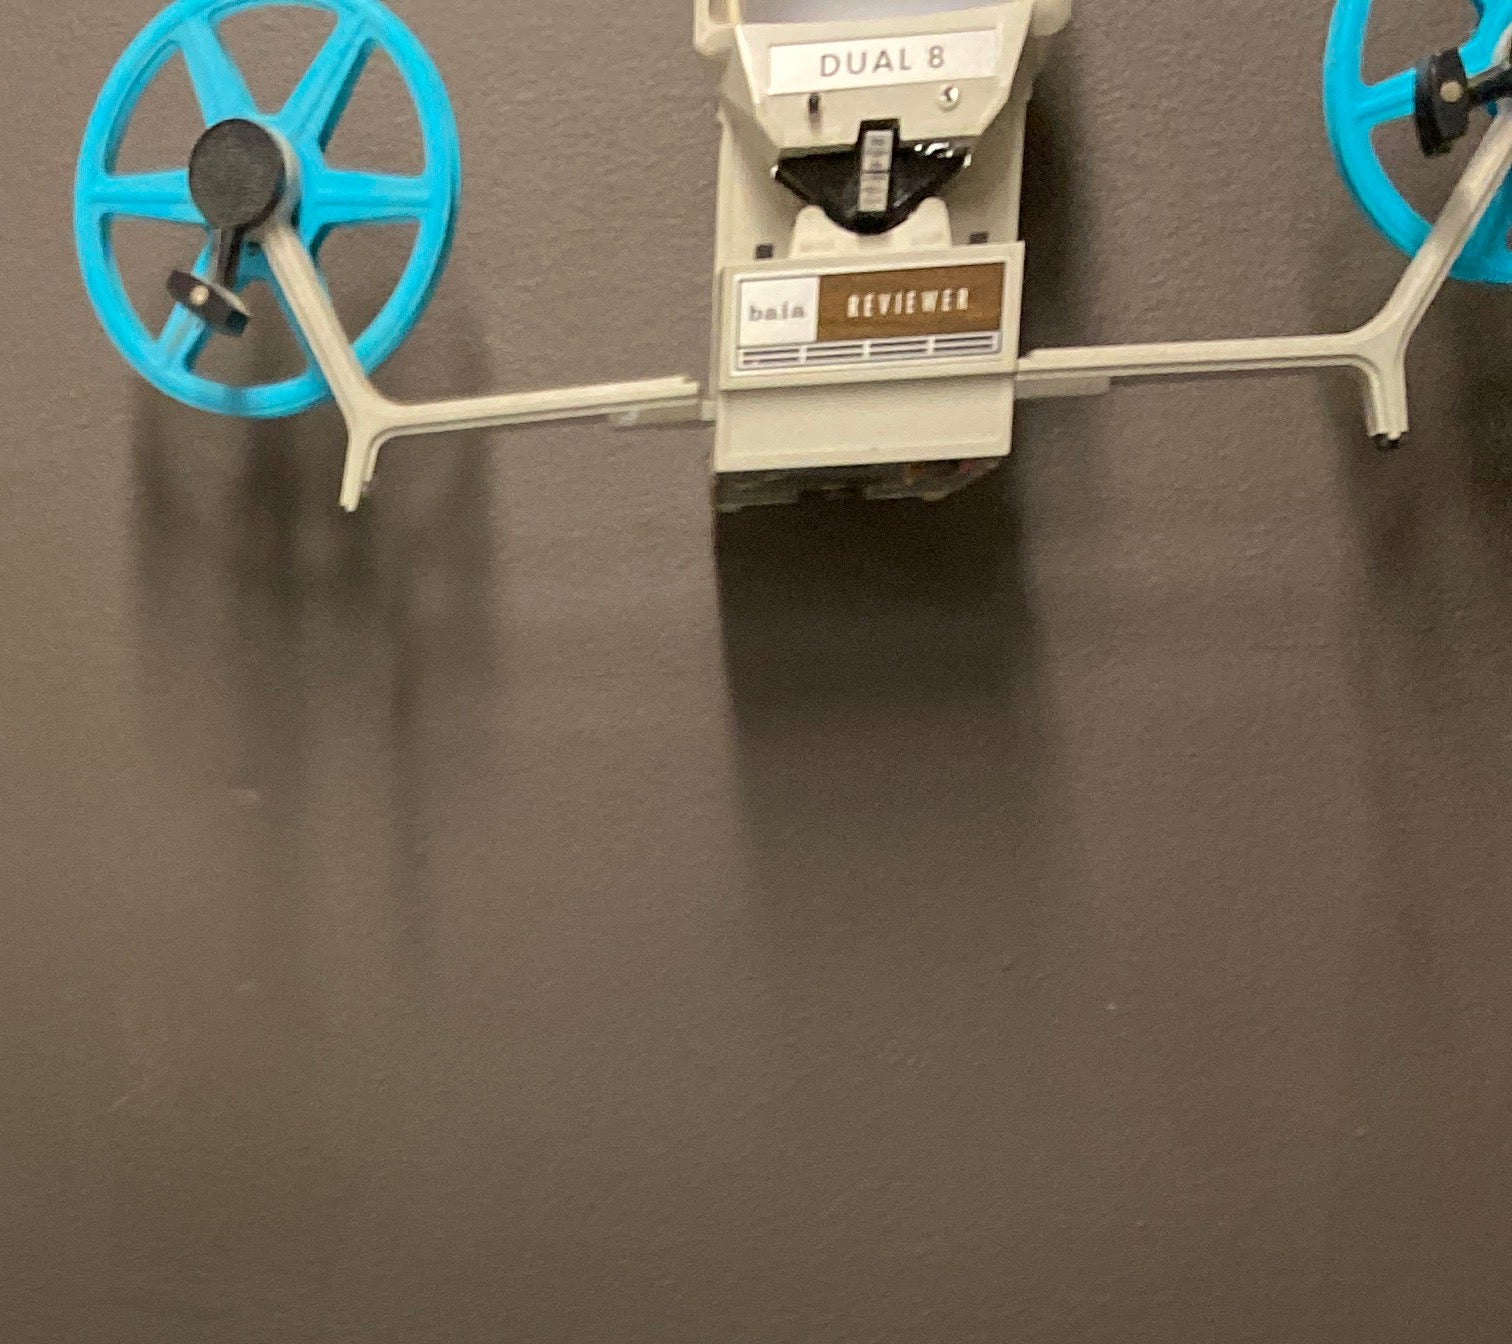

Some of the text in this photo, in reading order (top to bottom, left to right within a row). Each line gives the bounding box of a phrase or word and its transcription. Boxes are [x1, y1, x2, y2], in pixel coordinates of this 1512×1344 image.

[820, 45, 945, 77] DUAL 8
[847, 287, 969, 318] REVIEWER
